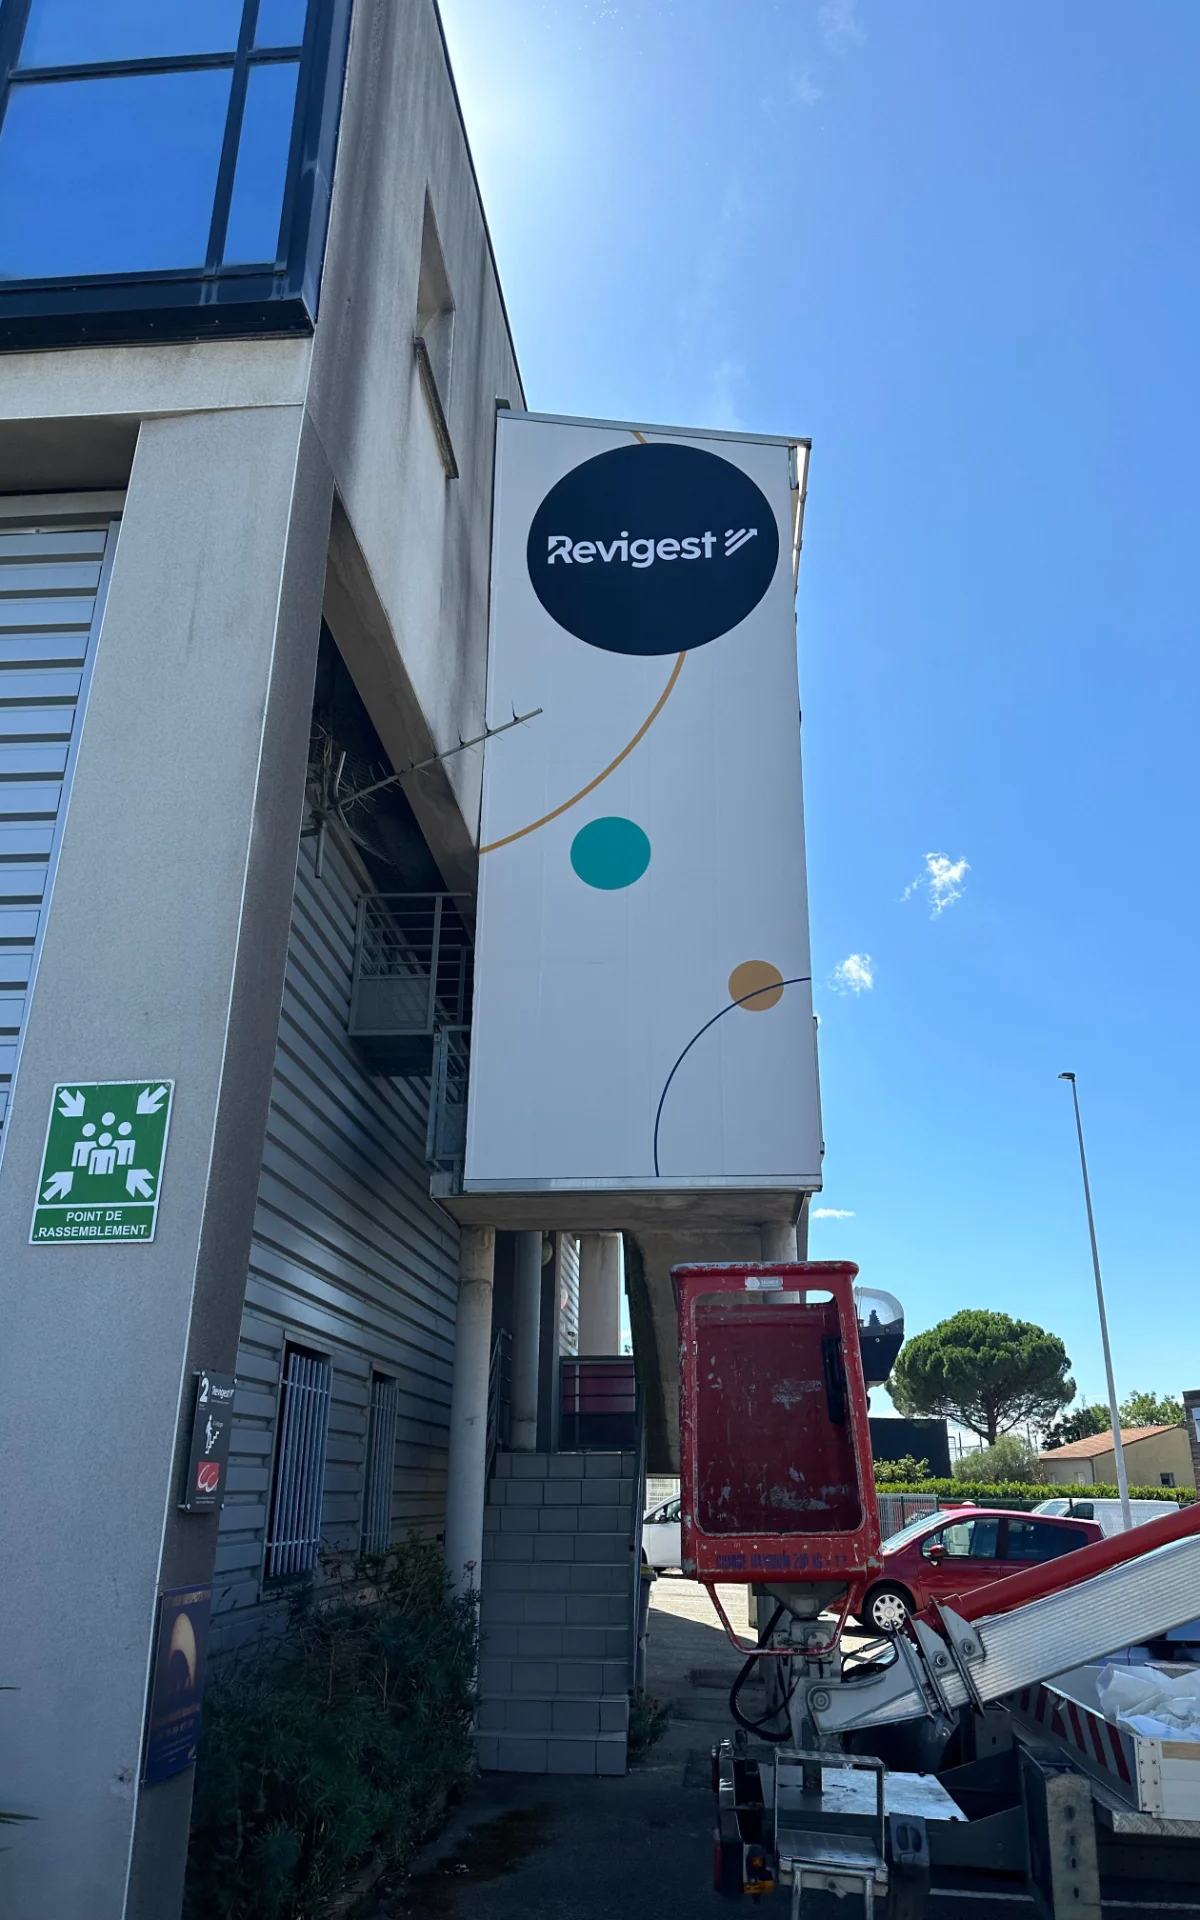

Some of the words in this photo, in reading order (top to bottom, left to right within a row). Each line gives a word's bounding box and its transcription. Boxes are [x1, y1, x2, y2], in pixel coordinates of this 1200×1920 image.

[547, 530, 717, 569] Revigest
[66, 1210, 103, 1222] POINT
[105, 1210, 123, 1221] DE
[38, 1224, 147, 1238] RASSEMBLEMENT
[199, 1377, 209, 1403] 2
